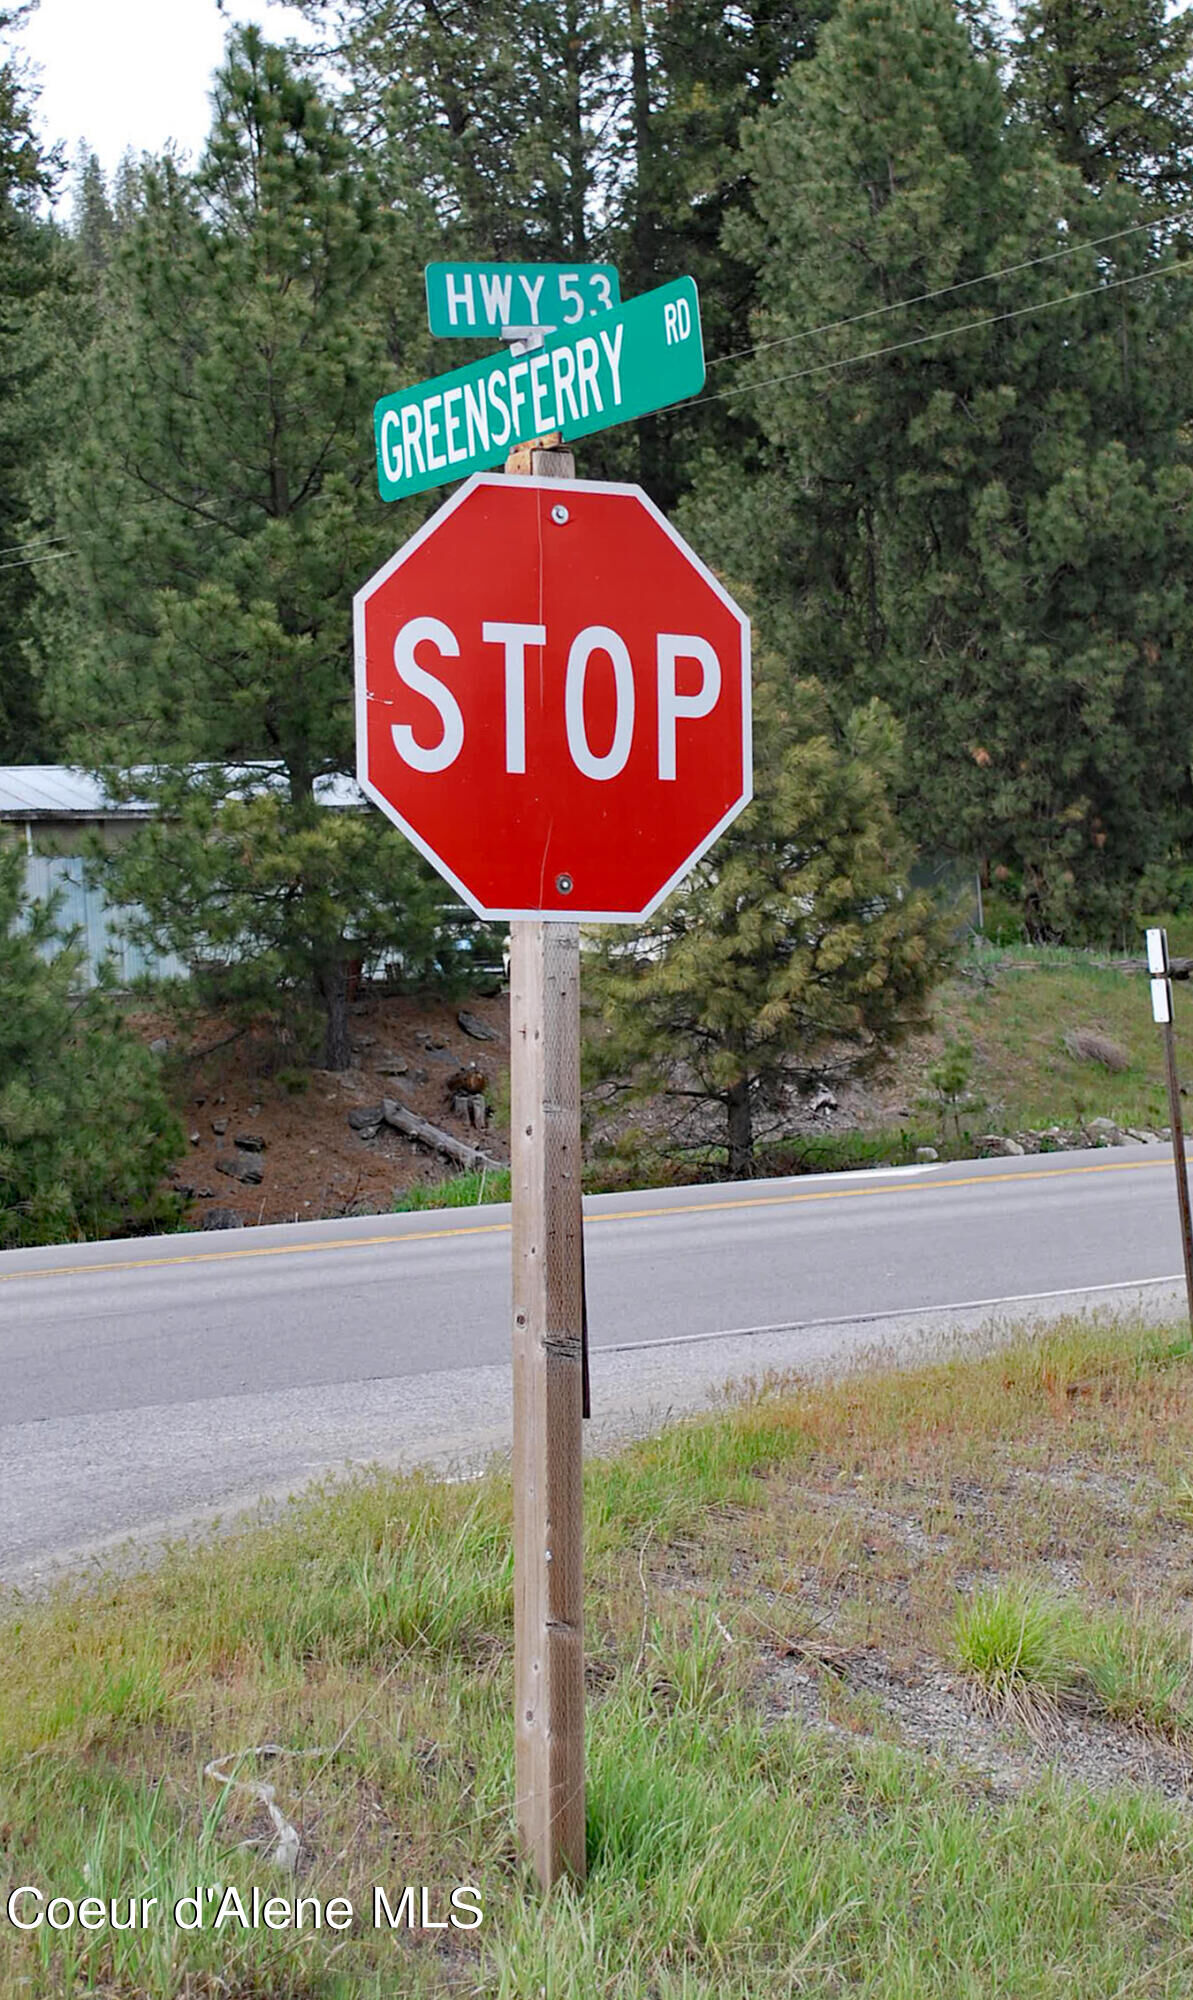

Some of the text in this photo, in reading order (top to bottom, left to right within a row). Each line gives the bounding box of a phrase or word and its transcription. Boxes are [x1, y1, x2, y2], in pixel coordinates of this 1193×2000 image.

[445, 273, 614, 326] HWY 53
[380, 298, 691, 483] GREENSFERRY RD
[390, 616, 722, 781] STOP
